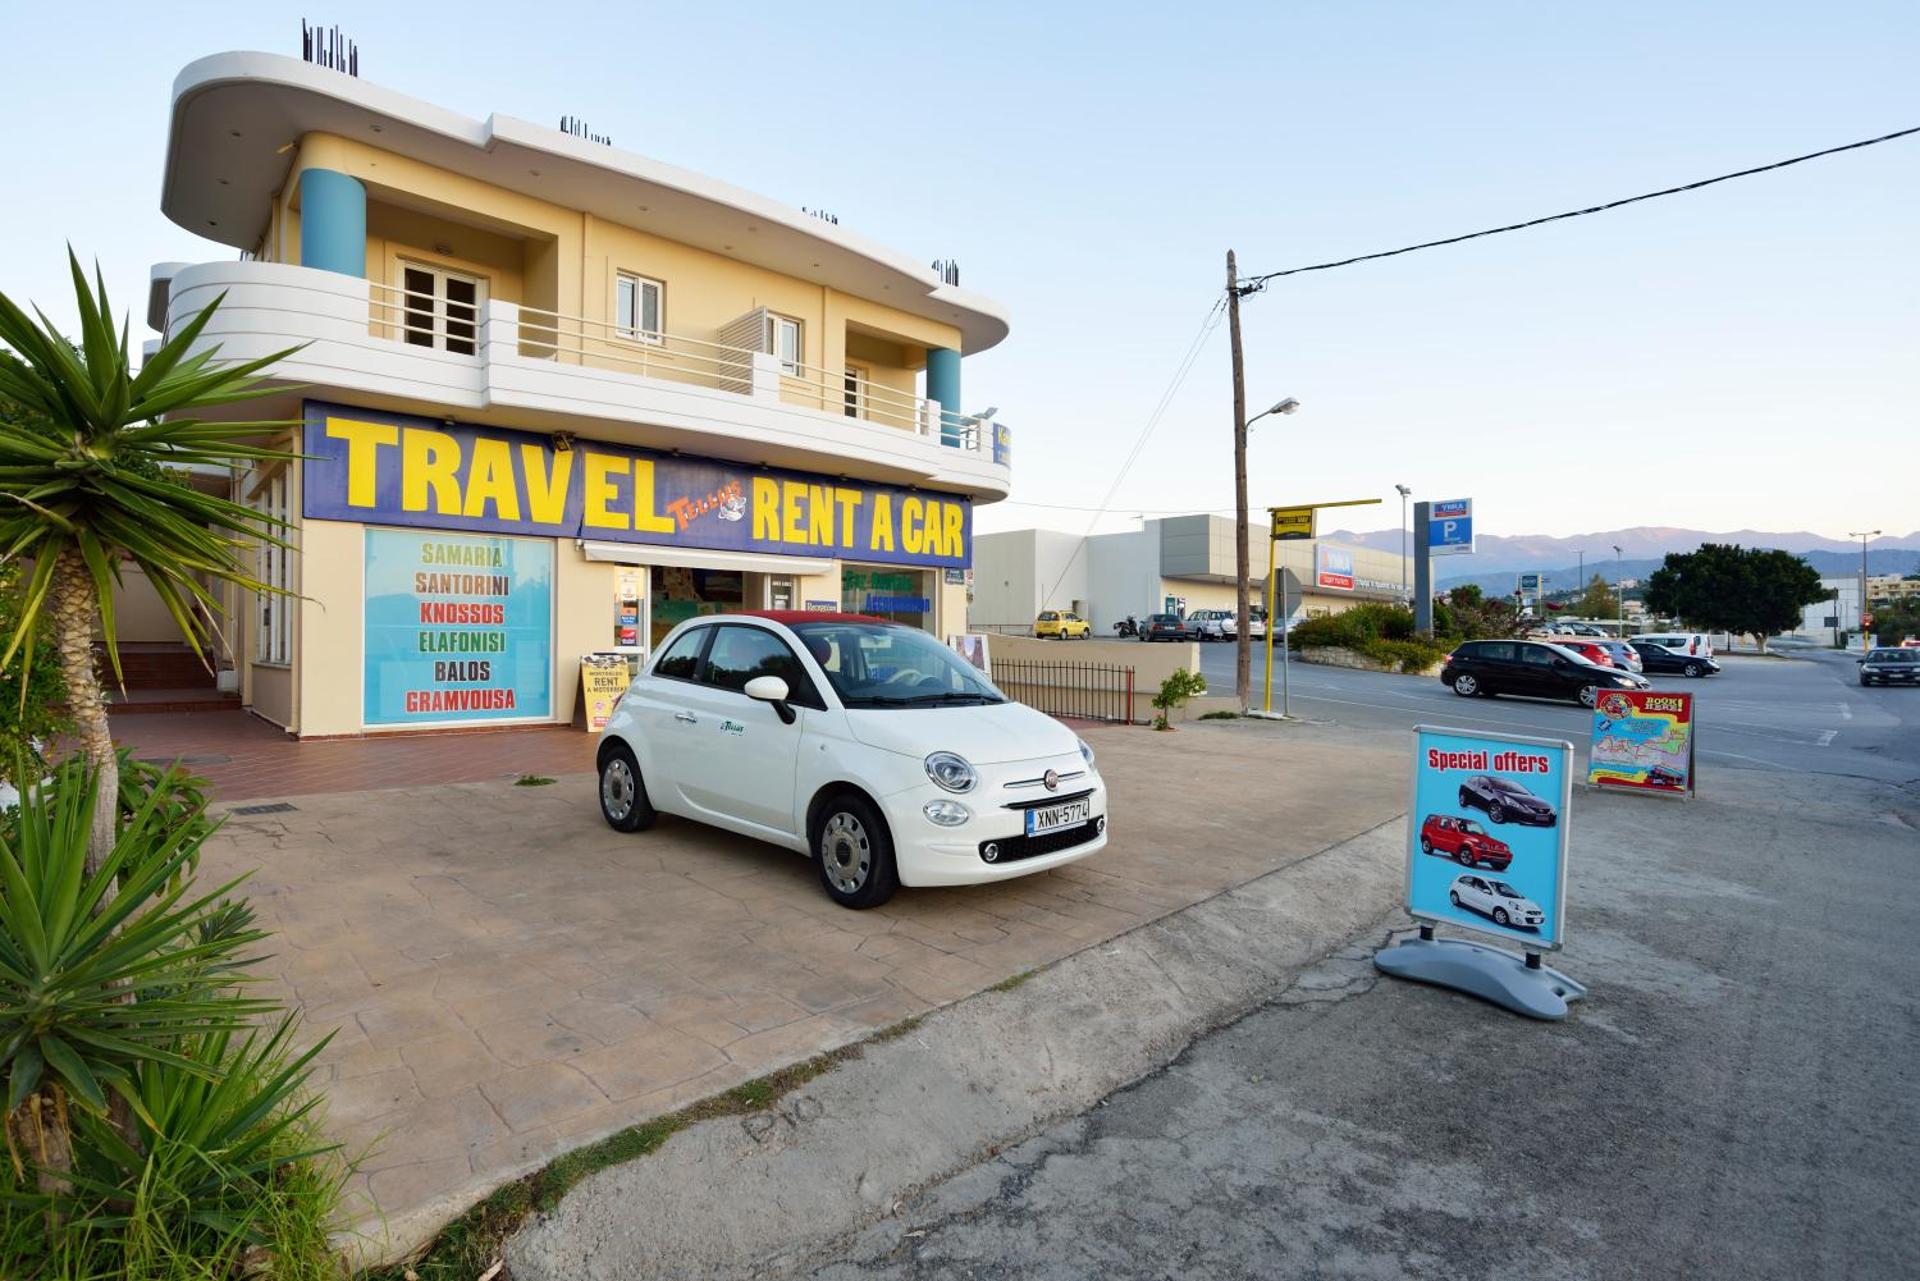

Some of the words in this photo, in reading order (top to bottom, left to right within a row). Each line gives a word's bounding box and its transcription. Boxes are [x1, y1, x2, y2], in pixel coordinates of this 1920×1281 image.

[326, 416, 675, 534] TRAVEL
[753, 477, 862, 548] RENT
[871, 494, 894, 552] A
[902, 497, 963, 558] CAR
[1443, 521, 1457, 538] P
[422, 543, 503, 567] SAMARIA
[415, 572, 509, 596] SANTORINI
[420, 602, 504, 624] KNOSSOS
[419, 631, 505, 652] ELAFONISI
[434, 661, 491, 682] BALOS
[594, 677, 619, 687] RENT
[406, 690, 515, 712] GRAMVOUSA
[1428, 749, 1488, 771] Special
[1494, 752, 1549, 773] offers
